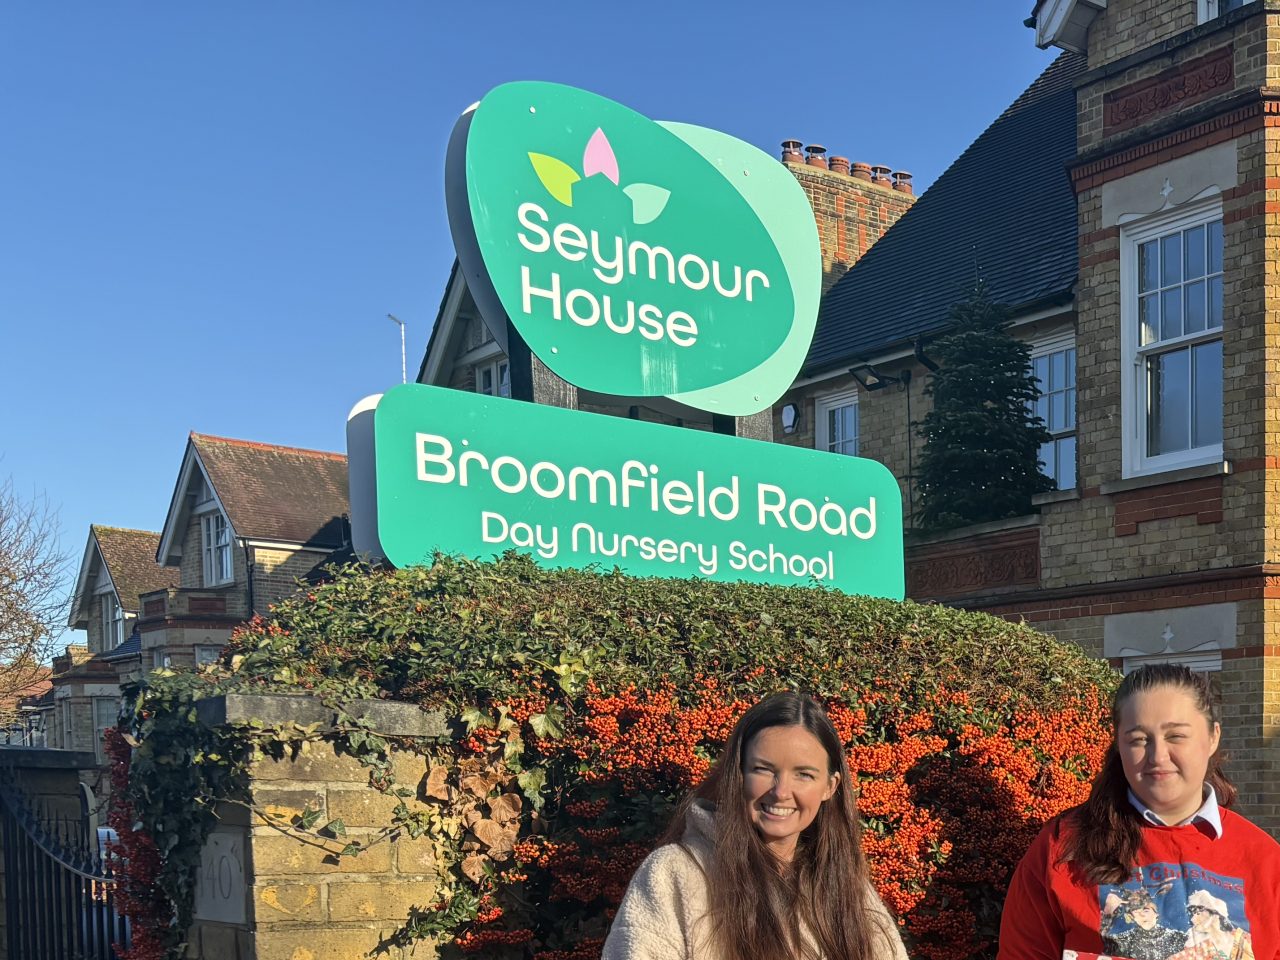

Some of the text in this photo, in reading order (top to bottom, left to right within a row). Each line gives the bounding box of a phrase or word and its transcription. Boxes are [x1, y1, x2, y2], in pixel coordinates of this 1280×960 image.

[517, 202, 770, 302] Seymour
[521, 265, 698, 347] House
[415, 432, 876, 540] Broomfield Road
[481, 511, 834, 581] Day Nursery School
